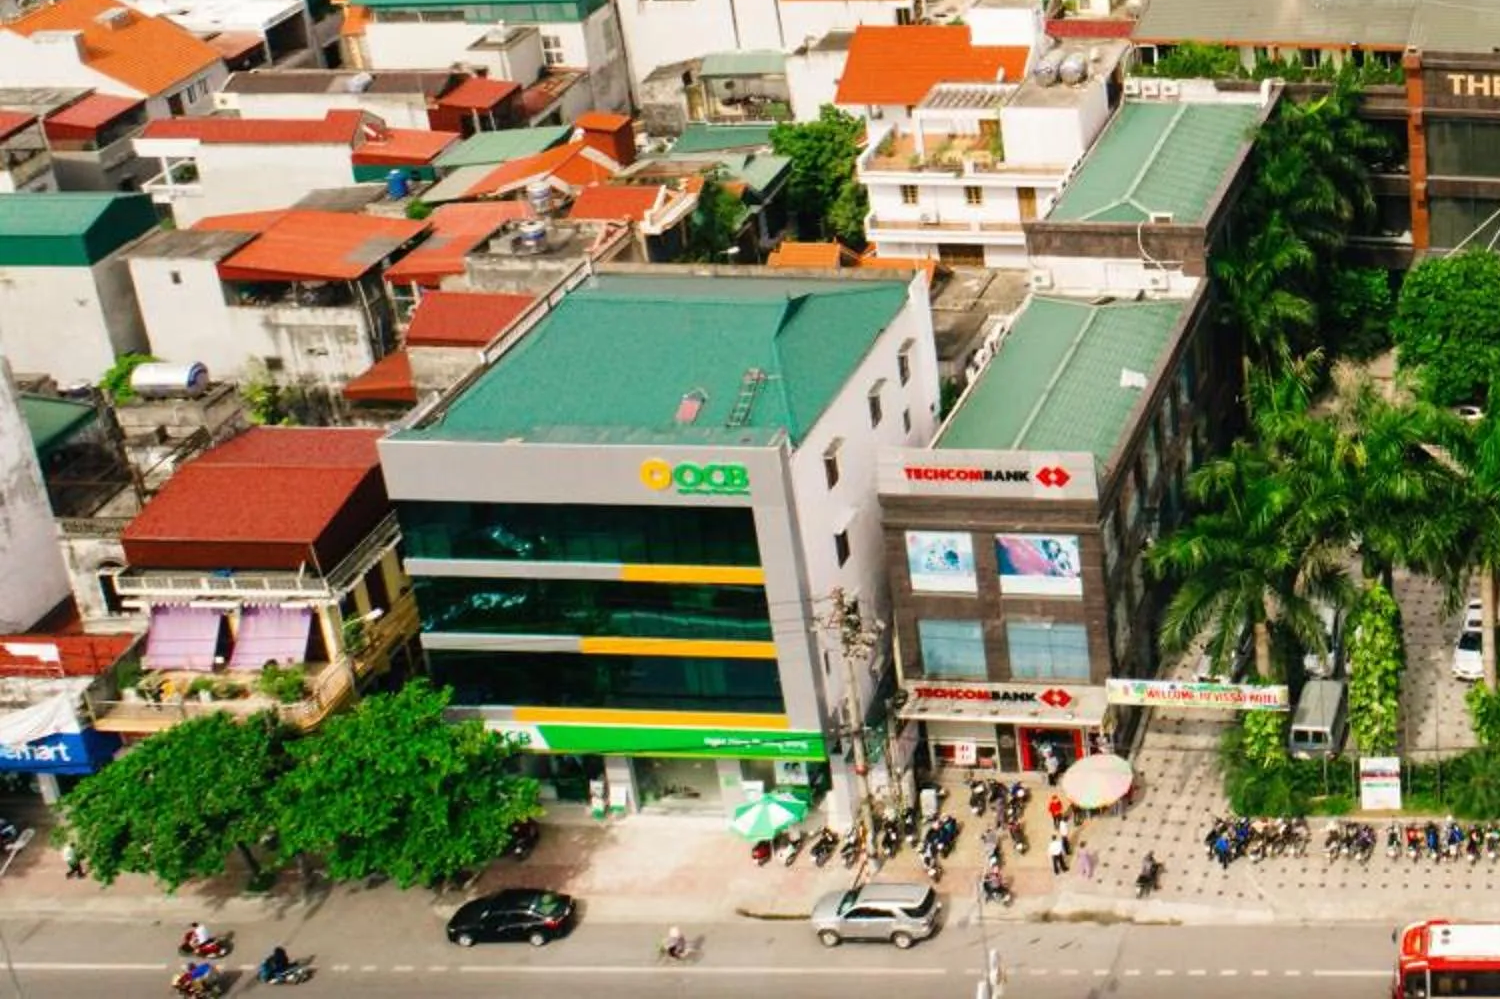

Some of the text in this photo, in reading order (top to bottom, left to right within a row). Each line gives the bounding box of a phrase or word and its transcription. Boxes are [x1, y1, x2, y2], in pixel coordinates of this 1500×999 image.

[673, 462, 749, 488] OCB
[904, 467, 1029, 482] TECHCOMBANK
[914, 687, 1037, 701] TECHCOMBANK
